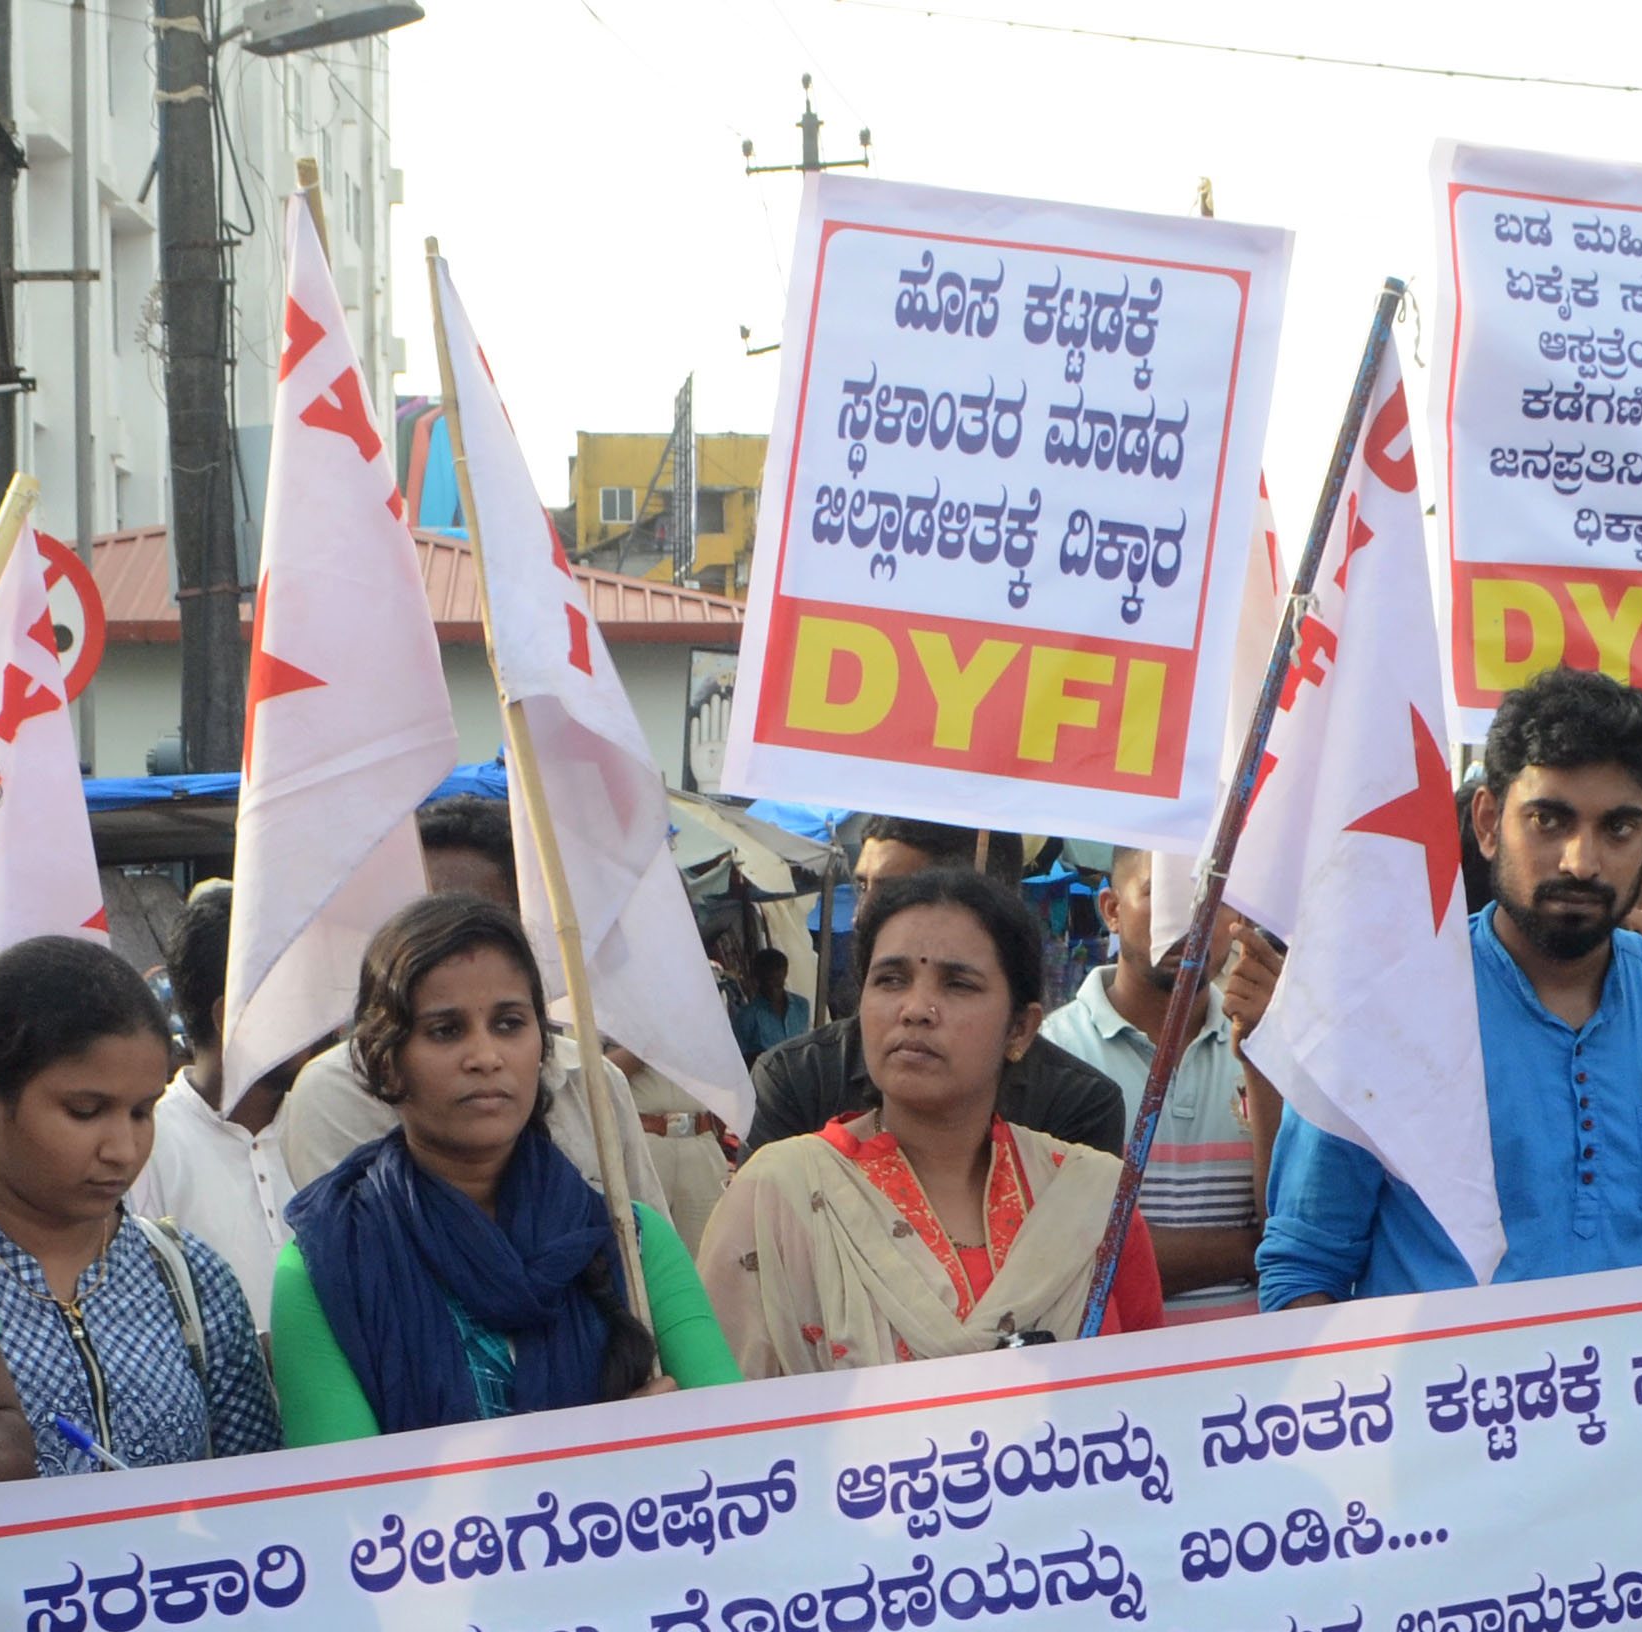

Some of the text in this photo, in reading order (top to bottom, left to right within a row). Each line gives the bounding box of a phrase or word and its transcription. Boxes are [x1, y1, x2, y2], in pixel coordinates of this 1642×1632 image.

[1494, 209, 1553, 247] ಬಡ
[1506, 265, 1600, 320] ಏಕೈಕ
[894, 250, 1163, 391] ಹೊಸ ಕಟ್ಟಡಕ್ಕೆ
[837, 361, 1189, 481] ಸ್ಥಳಾಂತರ ಮಾಡದ
[812, 477, 1042, 609] ಜಿಲ್ಲಾಡಳಿತಕ್ಕೆ
[785, 615, 1167, 776] DYFI
[350, 1460, 797, 1593] ಲೇಡಿಗೋಷನ್
[836, 1411, 1172, 1532] ಆಸ್ಪತ್ರೆಯನ್ನು
[1201, 1373, 1394, 1467] ನೂತನ
[1425, 1344, 1607, 1461] ಕಟ್ಟಡಕ್ಕೆ
